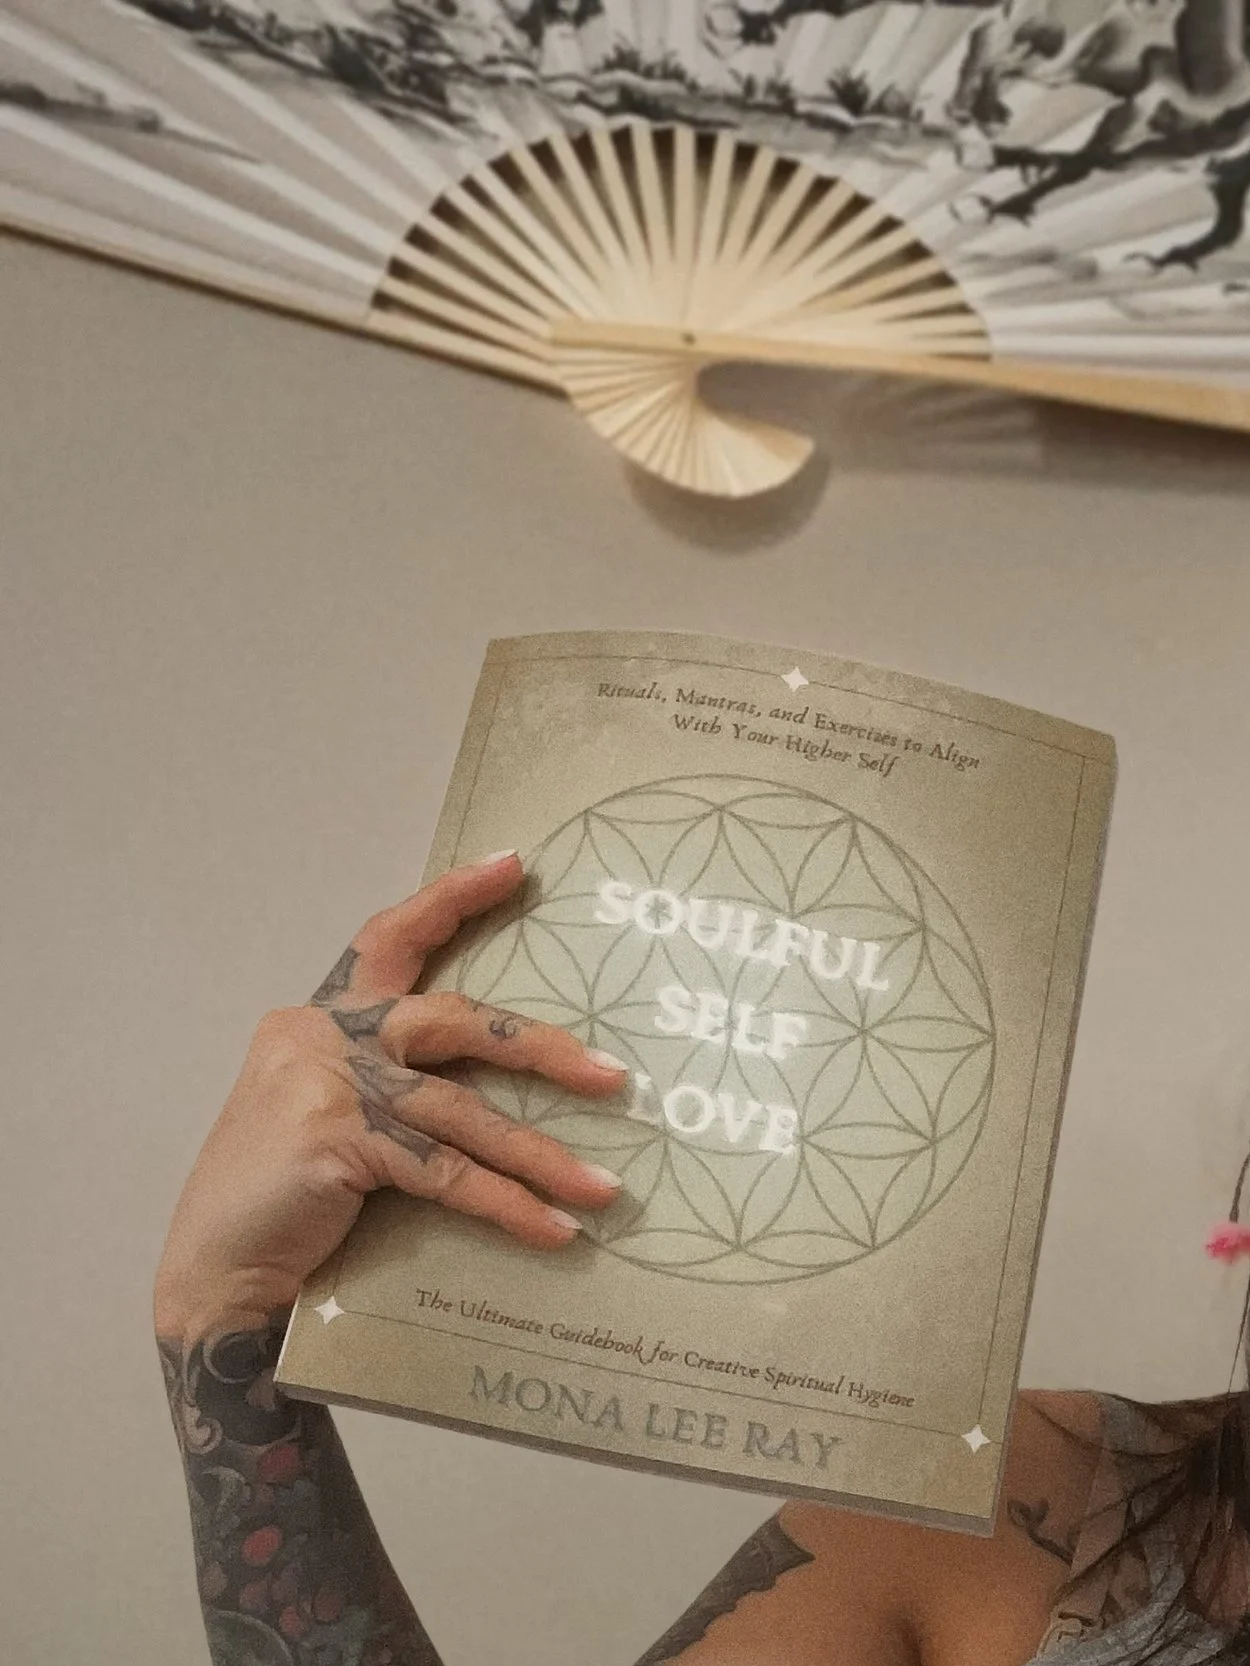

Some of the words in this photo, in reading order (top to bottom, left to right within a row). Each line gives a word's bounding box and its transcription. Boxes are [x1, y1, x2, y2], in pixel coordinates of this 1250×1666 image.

[597, 682, 667, 703] Rituals,
[676, 688, 762, 718] Mantras,
[769, 706, 809, 723] and
[815, 713, 898, 747] Exercises
[904, 738, 922, 752] to
[929, 742, 980, 771] Align
[673, 714, 722, 734] With
[733, 723, 779, 745] Your
[785, 735, 851, 762] Higher
[858, 752, 900, 778] Self
[594, 880, 889, 991] SOULFUL
[655, 984, 807, 1061] SELF
[627, 1071, 799, 1154] LOVE
[416, 1288, 453, 1312] The
[461, 1301, 543, 1334] Ultimate
[550, 1323, 645, 1363] Guidebook
[646, 1340, 676, 1365] for
[684, 1351, 760, 1379] Creative
[764, 1367, 844, 1396] Spiritual
[847, 1381, 915, 1408] Hygiene
[468, 1365, 623, 1432] MONA
[646, 1402, 727, 1449] LEE
[742, 1421, 842, 1470] RAY
